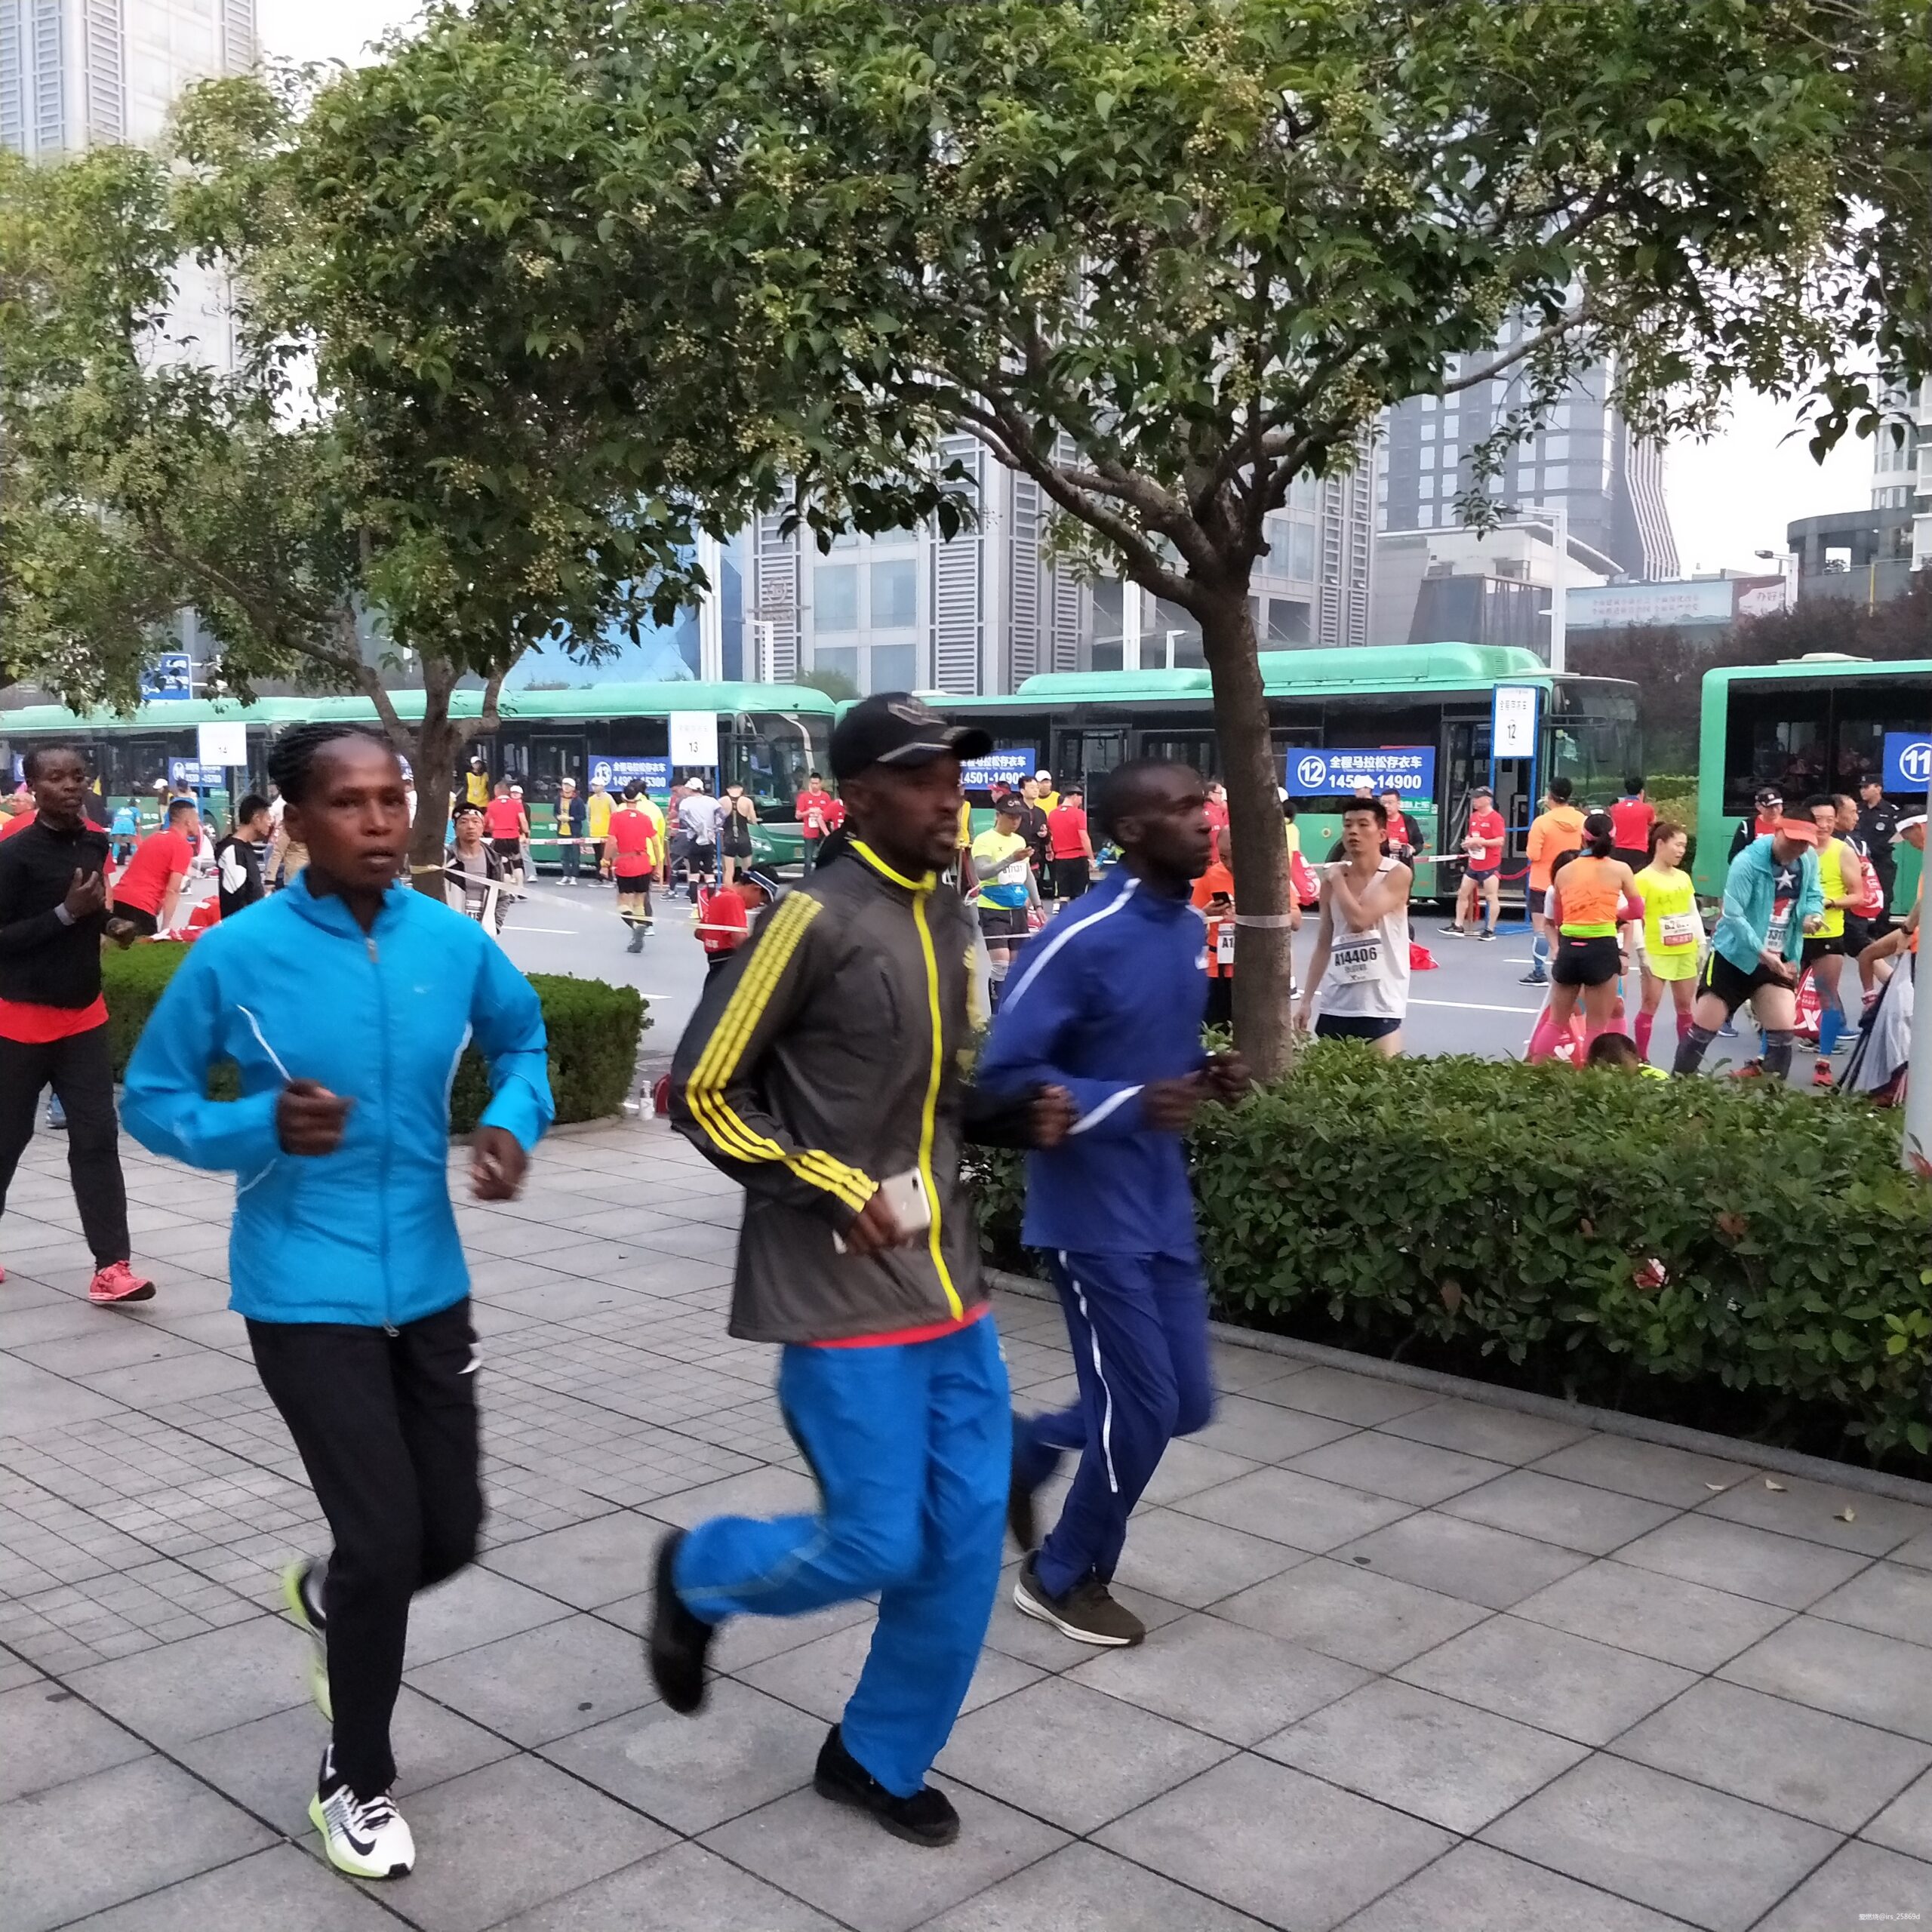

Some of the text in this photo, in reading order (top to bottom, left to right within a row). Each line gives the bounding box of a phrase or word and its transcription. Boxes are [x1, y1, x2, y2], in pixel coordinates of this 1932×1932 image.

[1507, 724, 1517, 739] 12
[688, 741, 699, 753] 13
[1329, 755, 1423, 769] 全程马拉松存衣车
[1904, 749, 1931, 776] 11
[1300, 760, 1324, 783] 12
[1329, 774, 1423, 789] 145-14900
[1334, 947, 1377, 967] A14406
